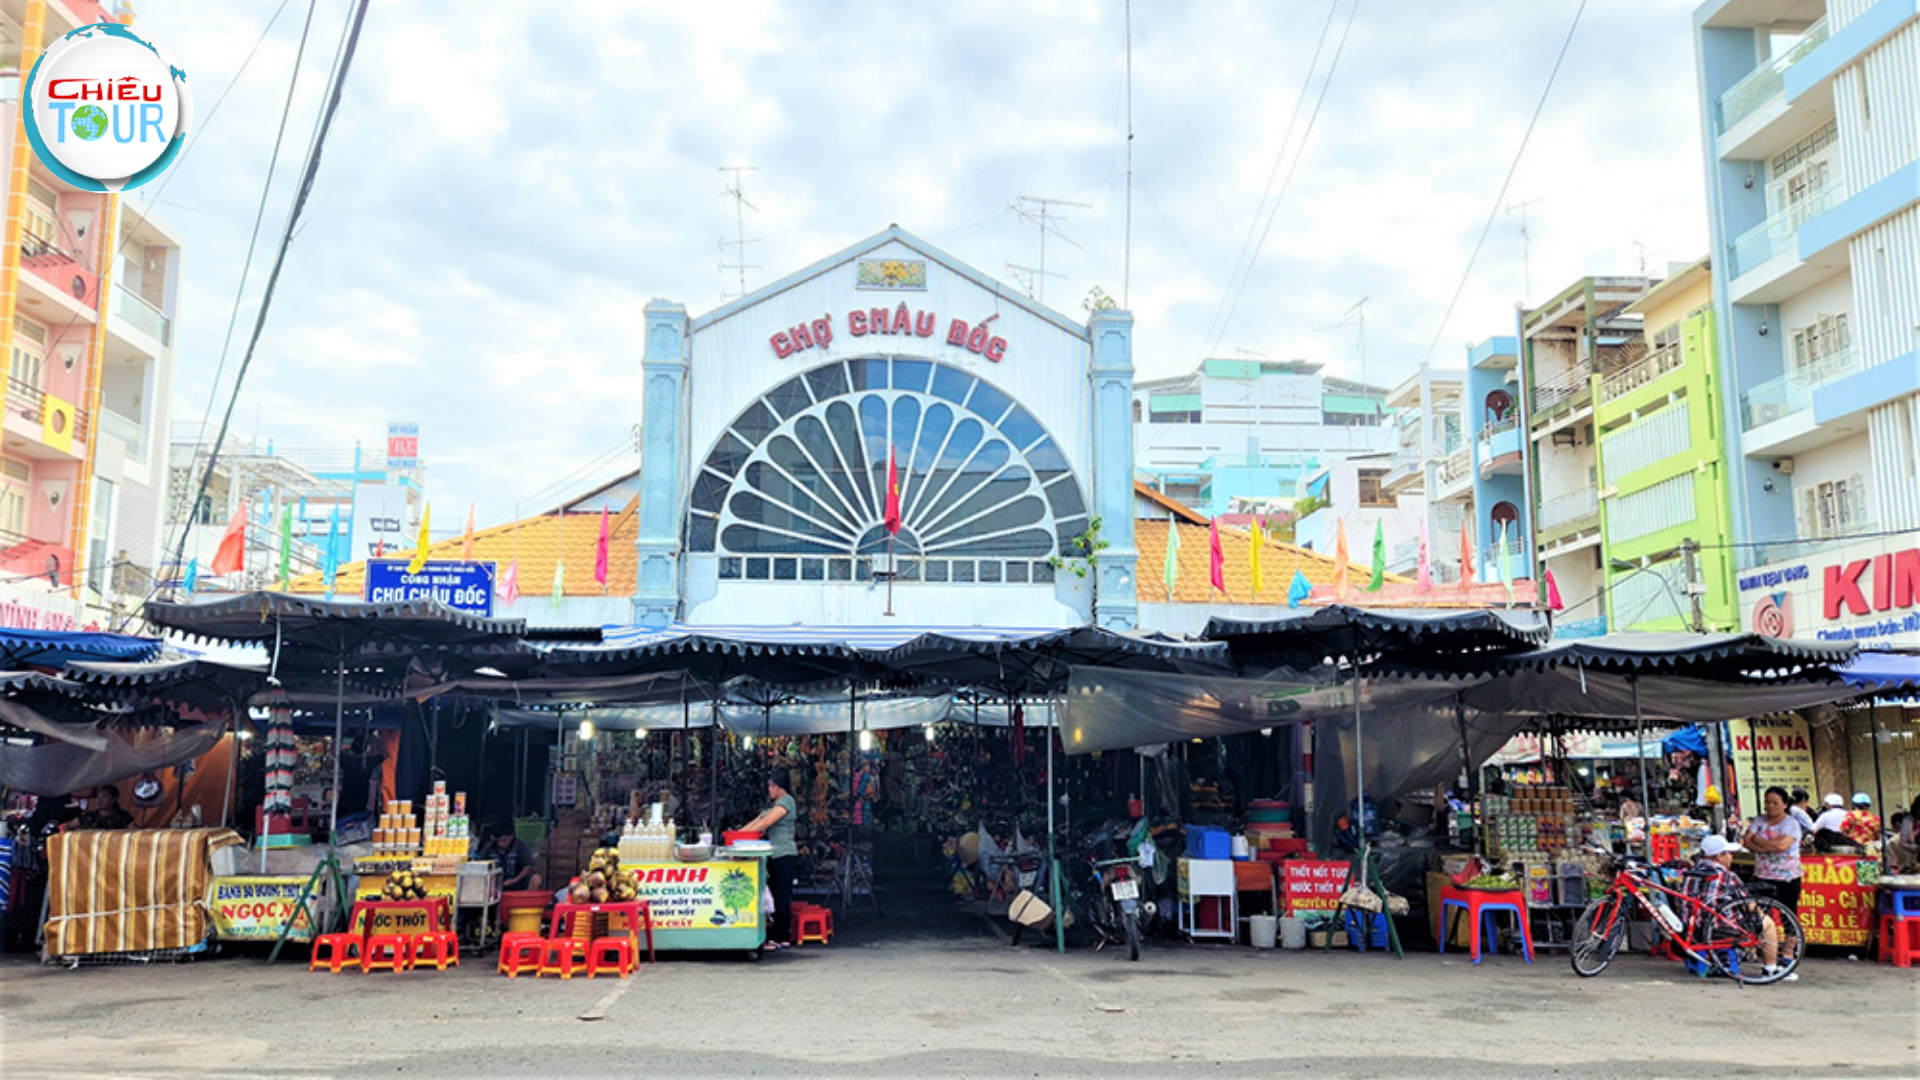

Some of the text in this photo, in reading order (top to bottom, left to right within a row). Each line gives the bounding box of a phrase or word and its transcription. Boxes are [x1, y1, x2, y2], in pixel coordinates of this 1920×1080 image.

[769, 301, 1008, 363] CHỢ CHÂU ĐỐC
[400, 573, 462, 587] CÔNG NHẬN
[454, 583, 487, 606] ĐỐC
[1736, 731, 1808, 751] KM HÀ
[1797, 890, 1825, 907] hía
[221, 902, 277, 924] NGỌC
[1822, 914, 1834, 928] &
